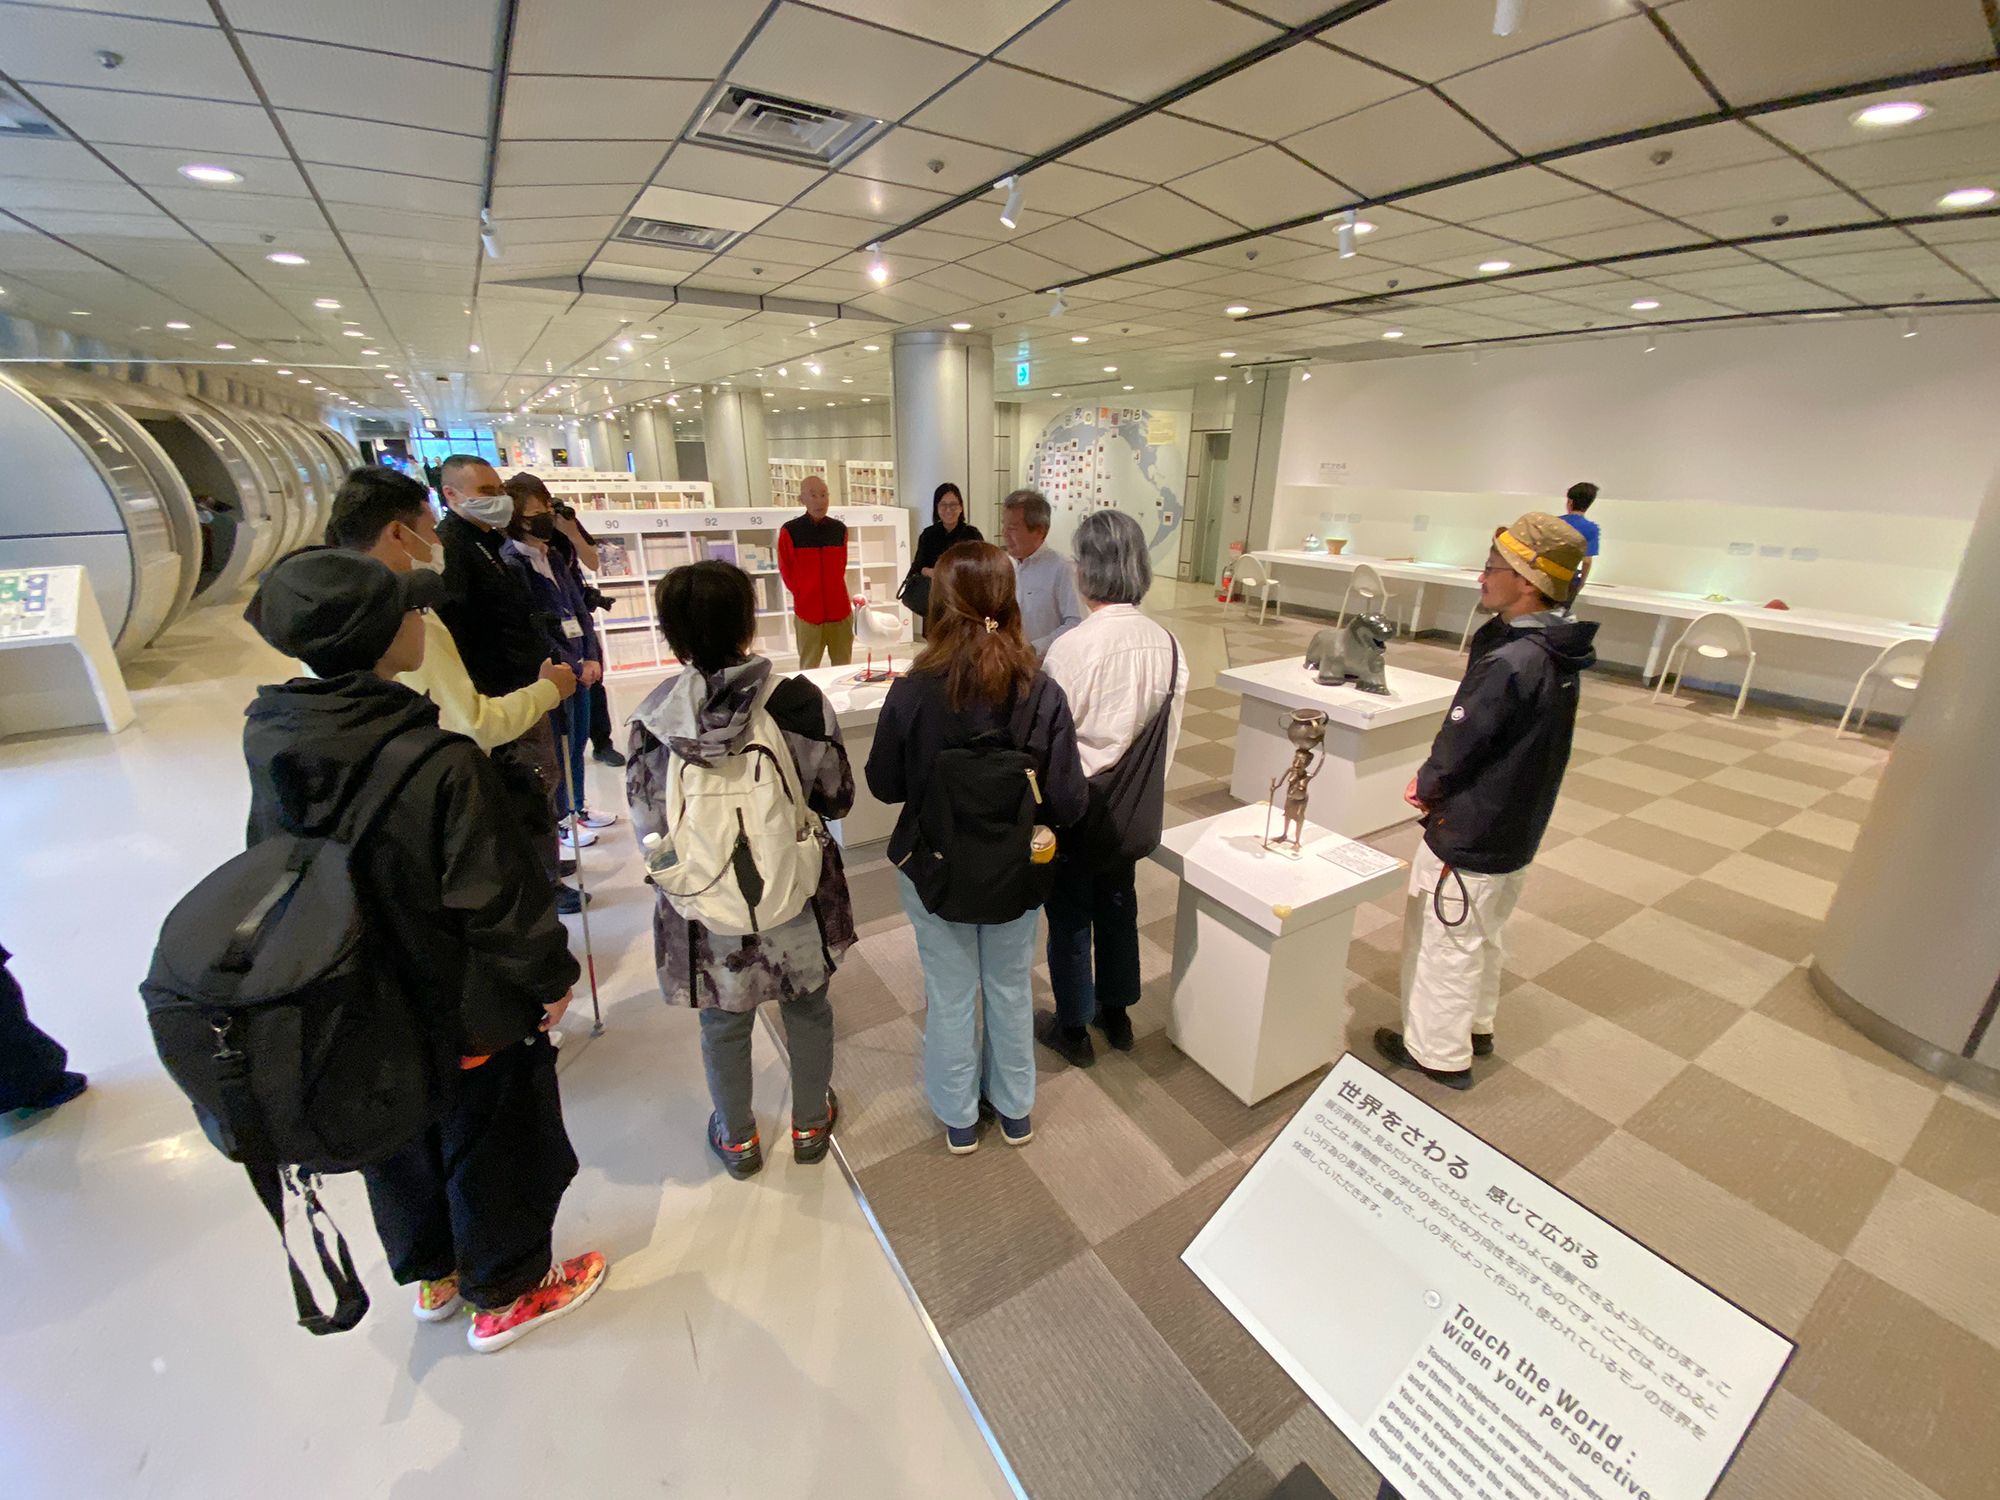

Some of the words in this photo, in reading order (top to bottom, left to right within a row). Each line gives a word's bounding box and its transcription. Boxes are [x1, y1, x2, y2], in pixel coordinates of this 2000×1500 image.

[605, 520, 620, 529] 90
[656, 518, 669, 528] 91
[704, 517, 719, 527] 92
[750, 516, 763, 525] 93
[872, 513, 884, 523] 96
[1337, 1079, 1470, 1180] 世界をさわる
[1485, 1184, 1599, 1270] 感じて広がる
[1416, 1360, 1430, 1372] of
[1427, 1368, 1453, 1398] them.
[1455, 1392, 1477, 1417] This
[1476, 1412, 1489, 1427] is
[1496, 1432, 1520, 1455] new
[1427, 1344, 1467, 1386] Touching
[1465, 1382, 1501, 1416] objects
[1500, 1413, 1544, 1453] enriches
[1542, 1450, 1569, 1474] your
[1442, 1319, 1492, 1371] Widen
[1493, 1368, 1537, 1406] your
[1454, 1303, 1511, 1361] Touch
[1515, 1357, 1551, 1393] the
[1555, 1387, 1624, 1453] World
[1368, 1427, 1403, 1466] through
[1401, 1461, 1418, 1481] the
[1378, 1414, 1405, 1443] depth
[1403, 1440, 1425, 1462] and
[1386, 1400, 1421, 1435] people
[1420, 1431, 1447, 1460] have
[1446, 1458, 1477, 1489] made
[1398, 1385, 1416, 1406] You
[1415, 1403, 1434, 1424] can
[1433, 1421, 1486, 1473] experience
[1485, 1469, 1504, 1491] the
[1407, 1373, 1427, 1392] and
[1424, 1388, 1464, 1429] learning
[1462, 1425, 1506, 1467] material
[1504, 1463, 1542, 1500] culture
